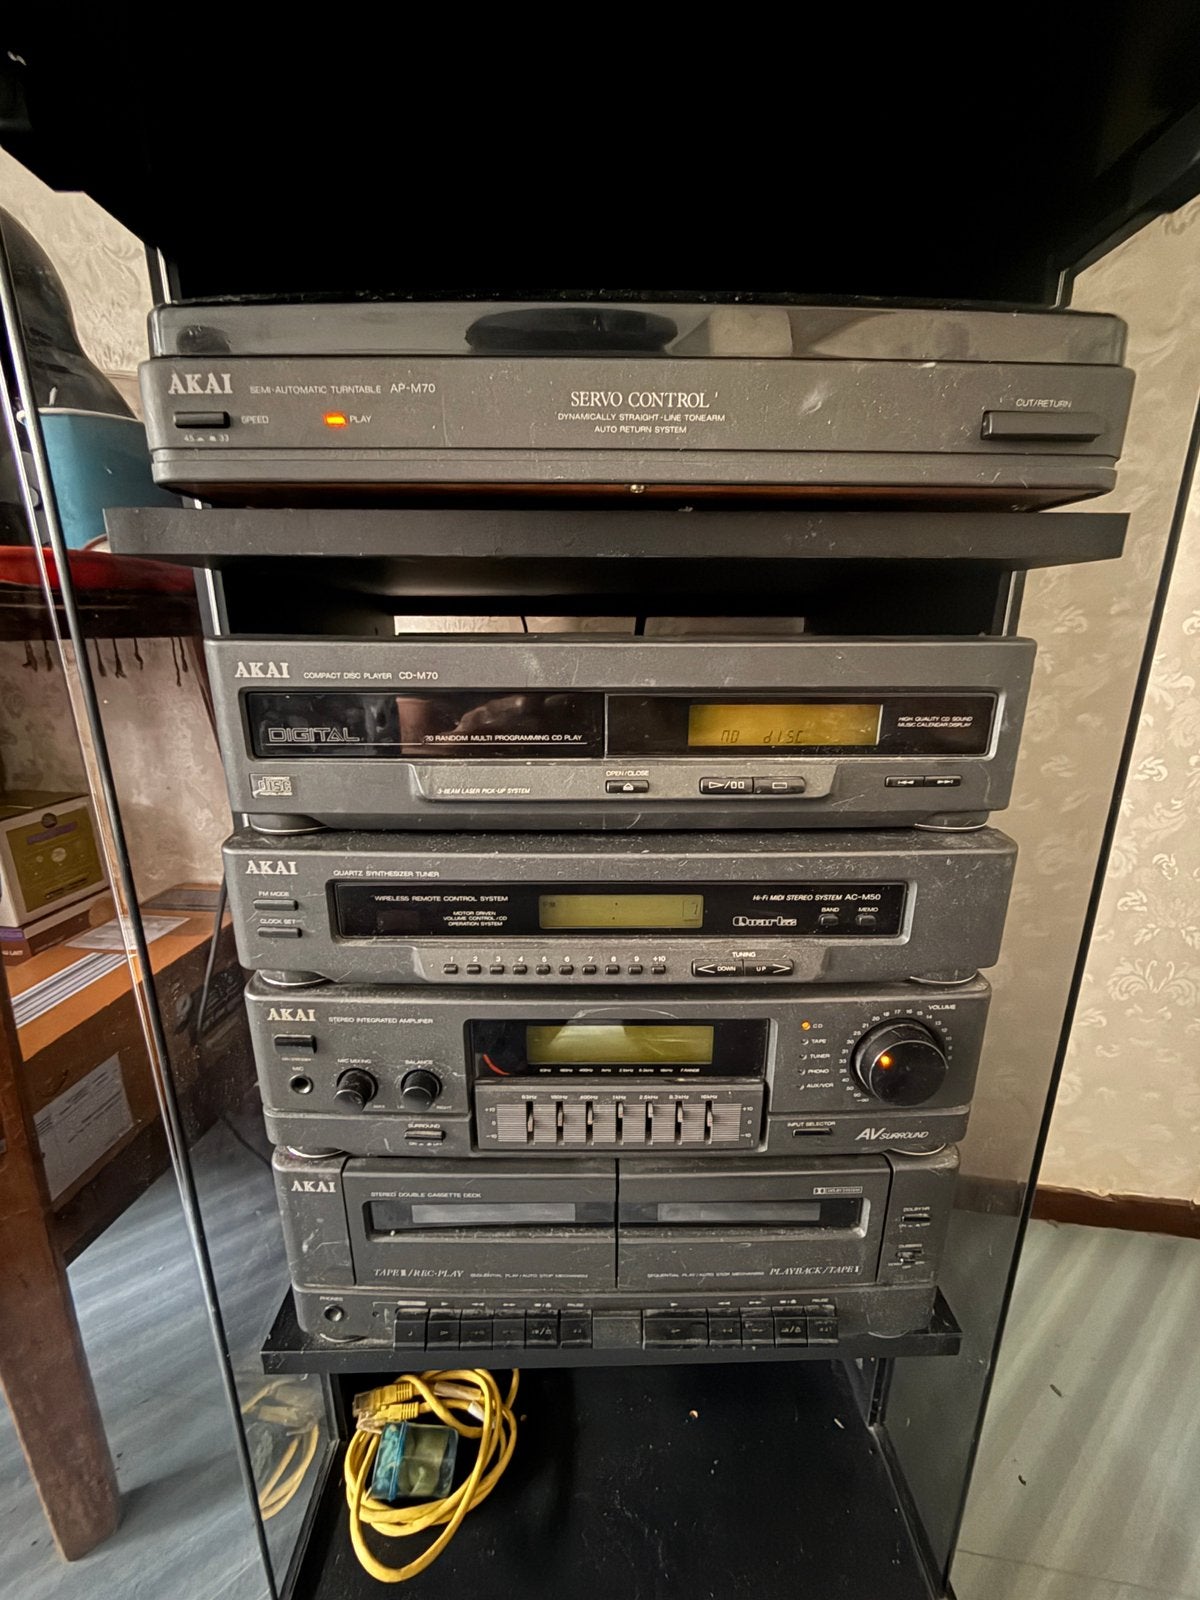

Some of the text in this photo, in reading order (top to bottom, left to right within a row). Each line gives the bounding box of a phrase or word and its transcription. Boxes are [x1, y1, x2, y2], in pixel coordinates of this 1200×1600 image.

[168, 373, 233, 394] AKAI
[250, 383, 436, 394] SEMI-AUTOMATIC TURNTABLE AP-M70
[570, 391, 710, 408] SERVO CONTROL
[241, 416, 269, 424] SPEED
[350, 415, 372, 424] PLAY
[558, 413, 616, 421] DYNAMICALLY
[685, 414, 725, 422] TONEARM
[654, 426, 687, 434] SYSTEM
[235, 661, 290, 678] AKAI
[363, 672, 392, 680] PLAYER
[399, 671, 439, 680] CD-M70
[268, 727, 361, 742] DIGITAL
[245, 860, 298, 875] AKAI
[844, 893, 881, 901] AC-M50
[449, 955, 454, 963] 1
[472, 955, 478, 963] 2
[495, 955, 501, 963] 3
[518, 955, 524, 963] 4
[541, 955, 547, 963] 5
[564, 955, 570, 963] 6
[588, 955, 594, 963] 7
[611, 955, 617, 963] 8
[634, 955, 640, 963] 9
[267, 1008, 316, 1021] AKAI
[855, 1128, 929, 1140] AV SURROUND
[291, 1181, 336, 1193] AKAI
